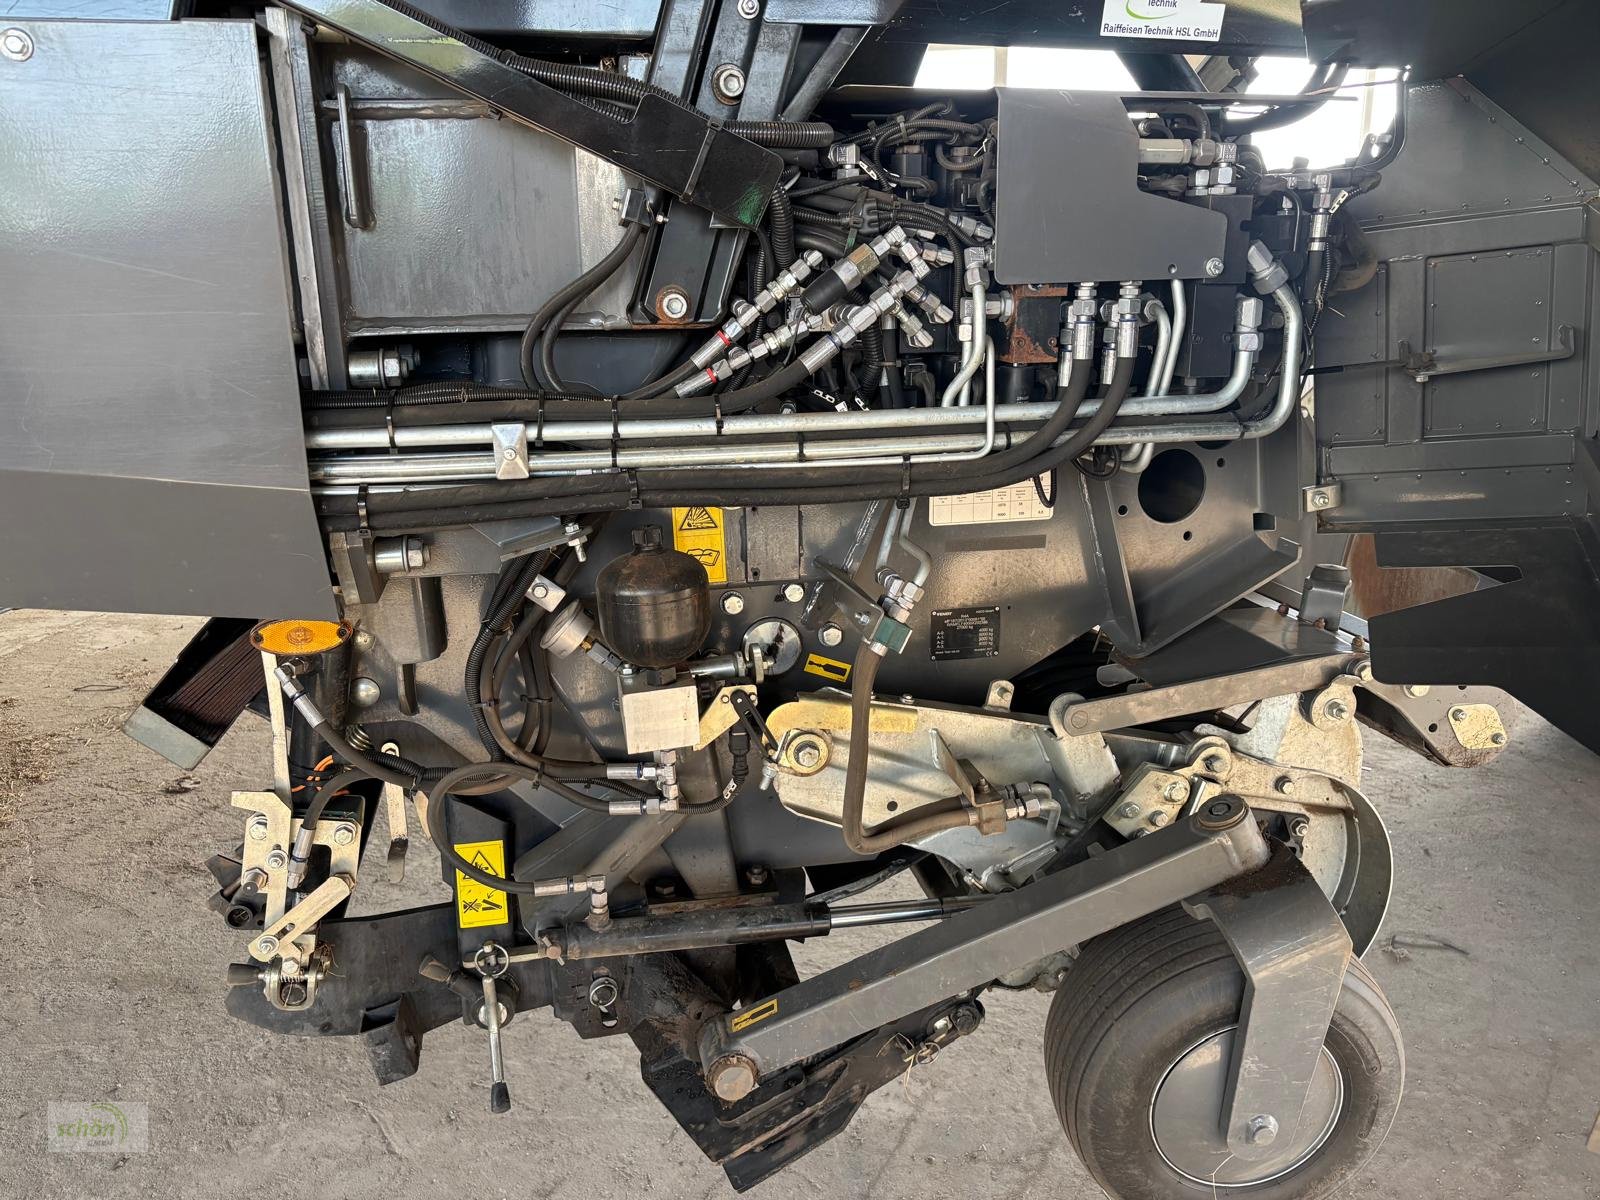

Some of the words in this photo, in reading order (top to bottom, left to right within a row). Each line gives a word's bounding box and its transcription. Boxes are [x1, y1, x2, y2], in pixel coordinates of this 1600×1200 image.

[1103, 23, 1143, 34] Raiffeisen
[1144, 25, 1174, 35] Technik
[1176, 26, 1192, 36] HSL
[1194, 28, 1219, 38] GmbH
